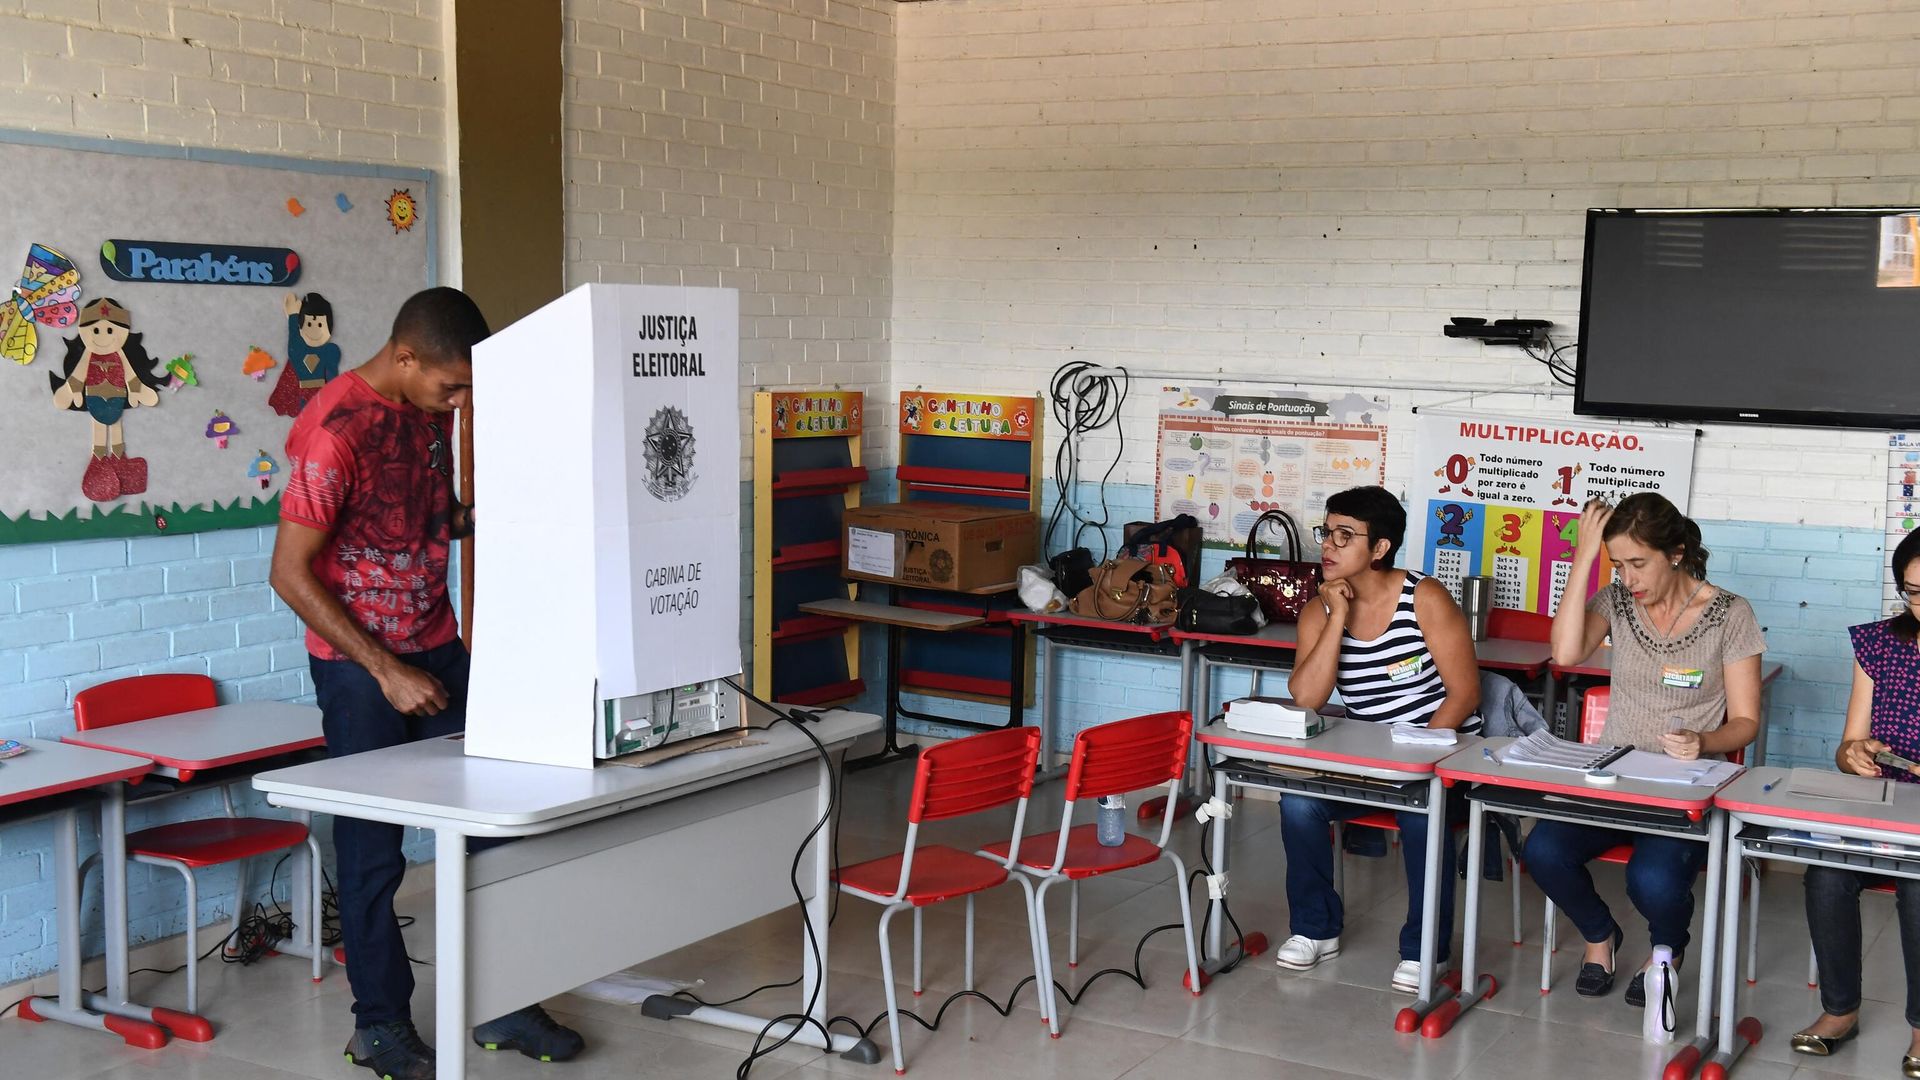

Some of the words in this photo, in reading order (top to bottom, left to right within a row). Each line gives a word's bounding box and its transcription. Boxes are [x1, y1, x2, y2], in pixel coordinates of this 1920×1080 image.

[128, 247, 273, 284] Parabéns
[639, 315, 697, 347] JUSTIÇA
[632, 353, 705, 377] ELEITORAL
[792, 397, 843, 415] CANTINHO
[927, 397, 1003, 417] CANTINHO
[1228, 400, 1254, 410] Sinais
[1256, 401, 1266, 411] de
[1267, 402, 1316, 415] Pontuação
[807, 415, 849, 432] LEITURA
[949, 416, 1011, 435] LEITURA
[1460, 421, 1644, 452] MULTIPLICAÇÃO.
[1446, 453, 1468, 484] 0
[1479, 453, 1503, 463] Todo
[1506, 456, 1543, 466] número
[1478, 466, 1539, 479] multiplicado
[1589, 462, 1617, 473] Todo
[1620, 465, 1665, 477] número
[1477, 479, 1494, 487] por
[1496, 480, 1517, 489] zero
[1519, 481, 1526, 490] é
[1557, 466, 1573, 495] 1
[1587, 476, 1661, 490] multiplicado
[1477, 489, 1501, 500] igual
[1512, 494, 1536, 503] zero.
[1586, 489, 1606, 497] por
[1609, 490, 1615, 498] 1
[1619, 490, 1627, 499] é
[1440, 504, 1465, 536] 2
[1501, 513, 1522, 543] 3
[902, 528, 940, 542] RÔNICA
[1560, 518, 1579, 547] 4
[645, 564, 685, 589] CABINA
[687, 562, 702, 582] DE
[903, 573, 930, 583] LEITORAL
[650, 587, 699, 616] VOTAÇÃO
